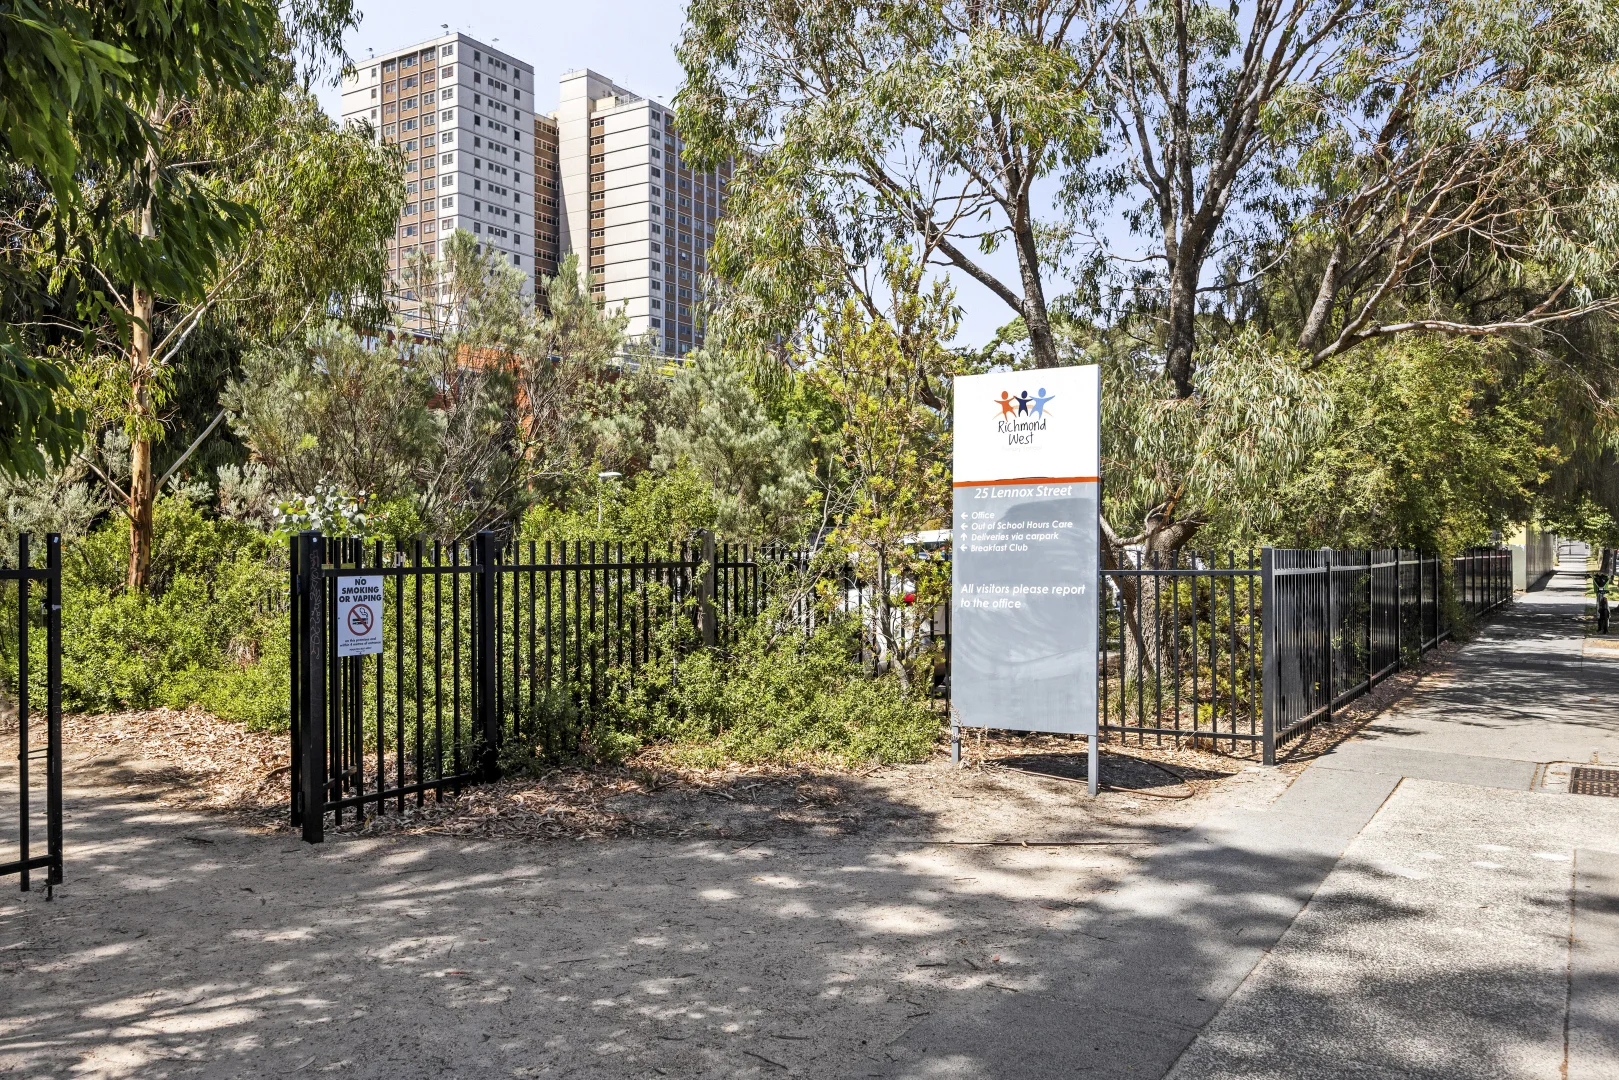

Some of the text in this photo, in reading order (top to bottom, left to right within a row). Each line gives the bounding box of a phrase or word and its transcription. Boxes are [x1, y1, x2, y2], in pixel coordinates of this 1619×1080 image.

[998, 418, 1046, 433] Richmond
[1009, 432, 1034, 445] West
[974, 485, 1072, 499] 25 Lennox Street
[971, 511, 995, 519] Office
[971, 520, 1073, 530] Out of School Hours Care
[971, 532, 1009, 541] Deliveries
[1025, 532, 1059, 542] carpark
[970, 543, 1028, 552] Breakfast Club
[341, 586, 379, 594] SMOKING
[960, 584, 1086, 597] All visitors please report
[352, 594, 382, 602] VAPING
[960, 598, 1022, 609] to the office
